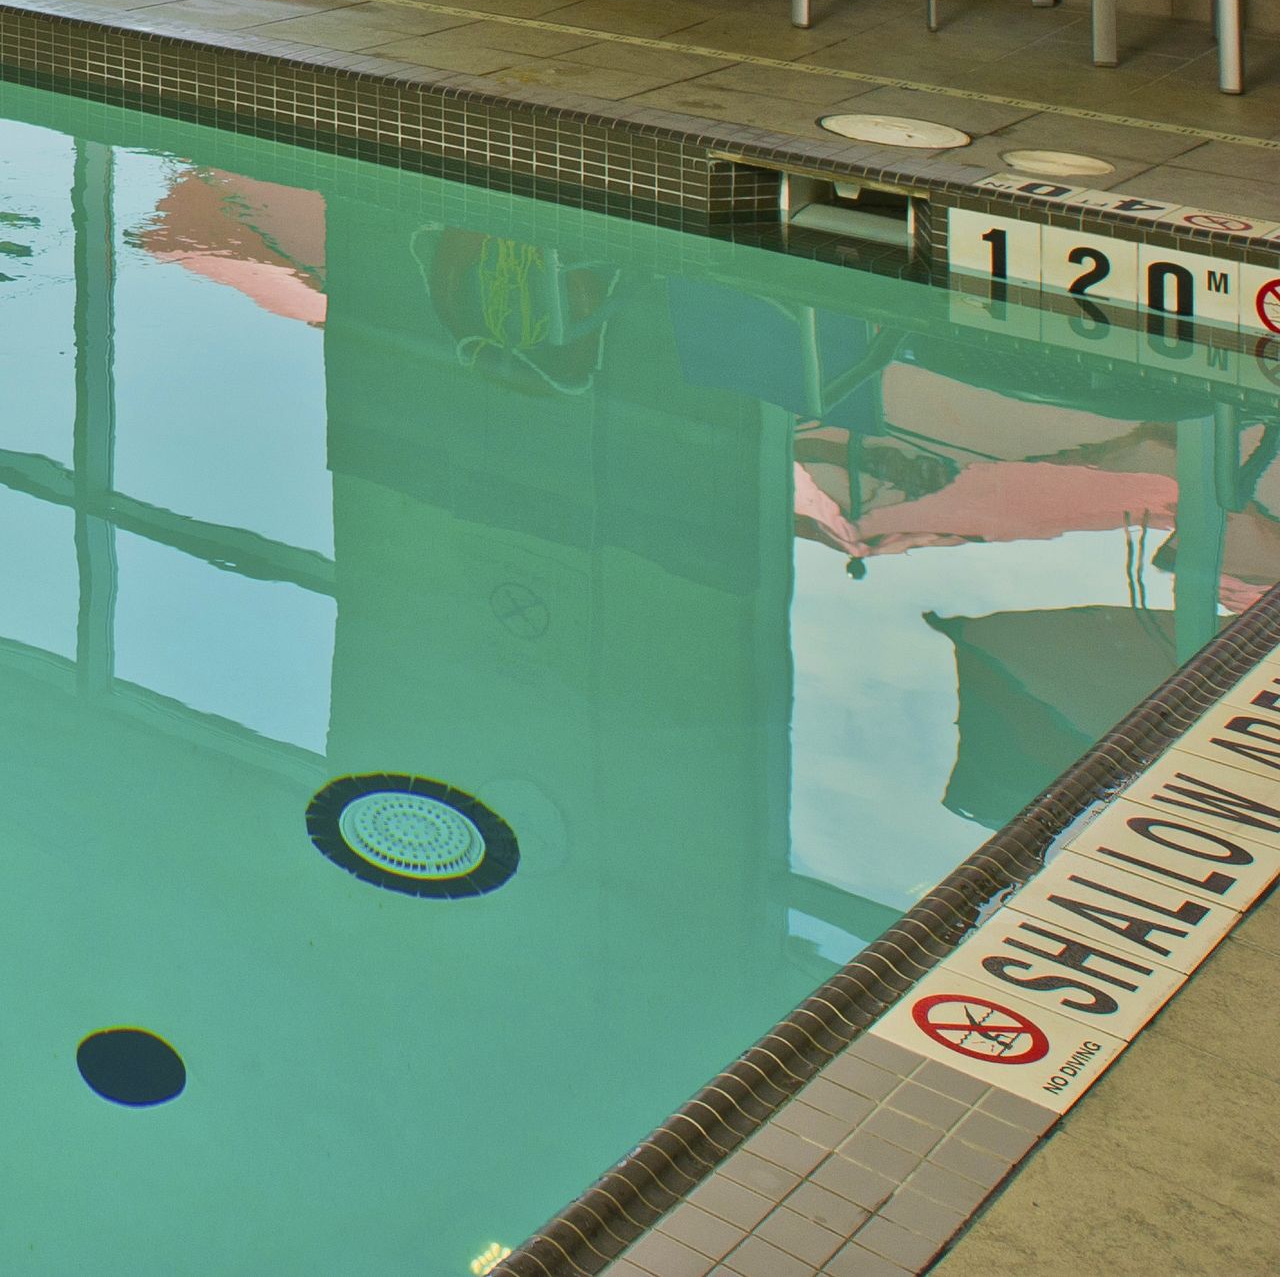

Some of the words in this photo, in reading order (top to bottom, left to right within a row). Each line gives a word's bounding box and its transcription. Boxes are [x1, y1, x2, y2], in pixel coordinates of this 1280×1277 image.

[1206, 269, 1230, 295] M
[981, 772, 1280, 1015] SHALLOW
[1042, 1068, 1069, 1096] NO
[1059, 1039, 1101, 1079] DIVING
